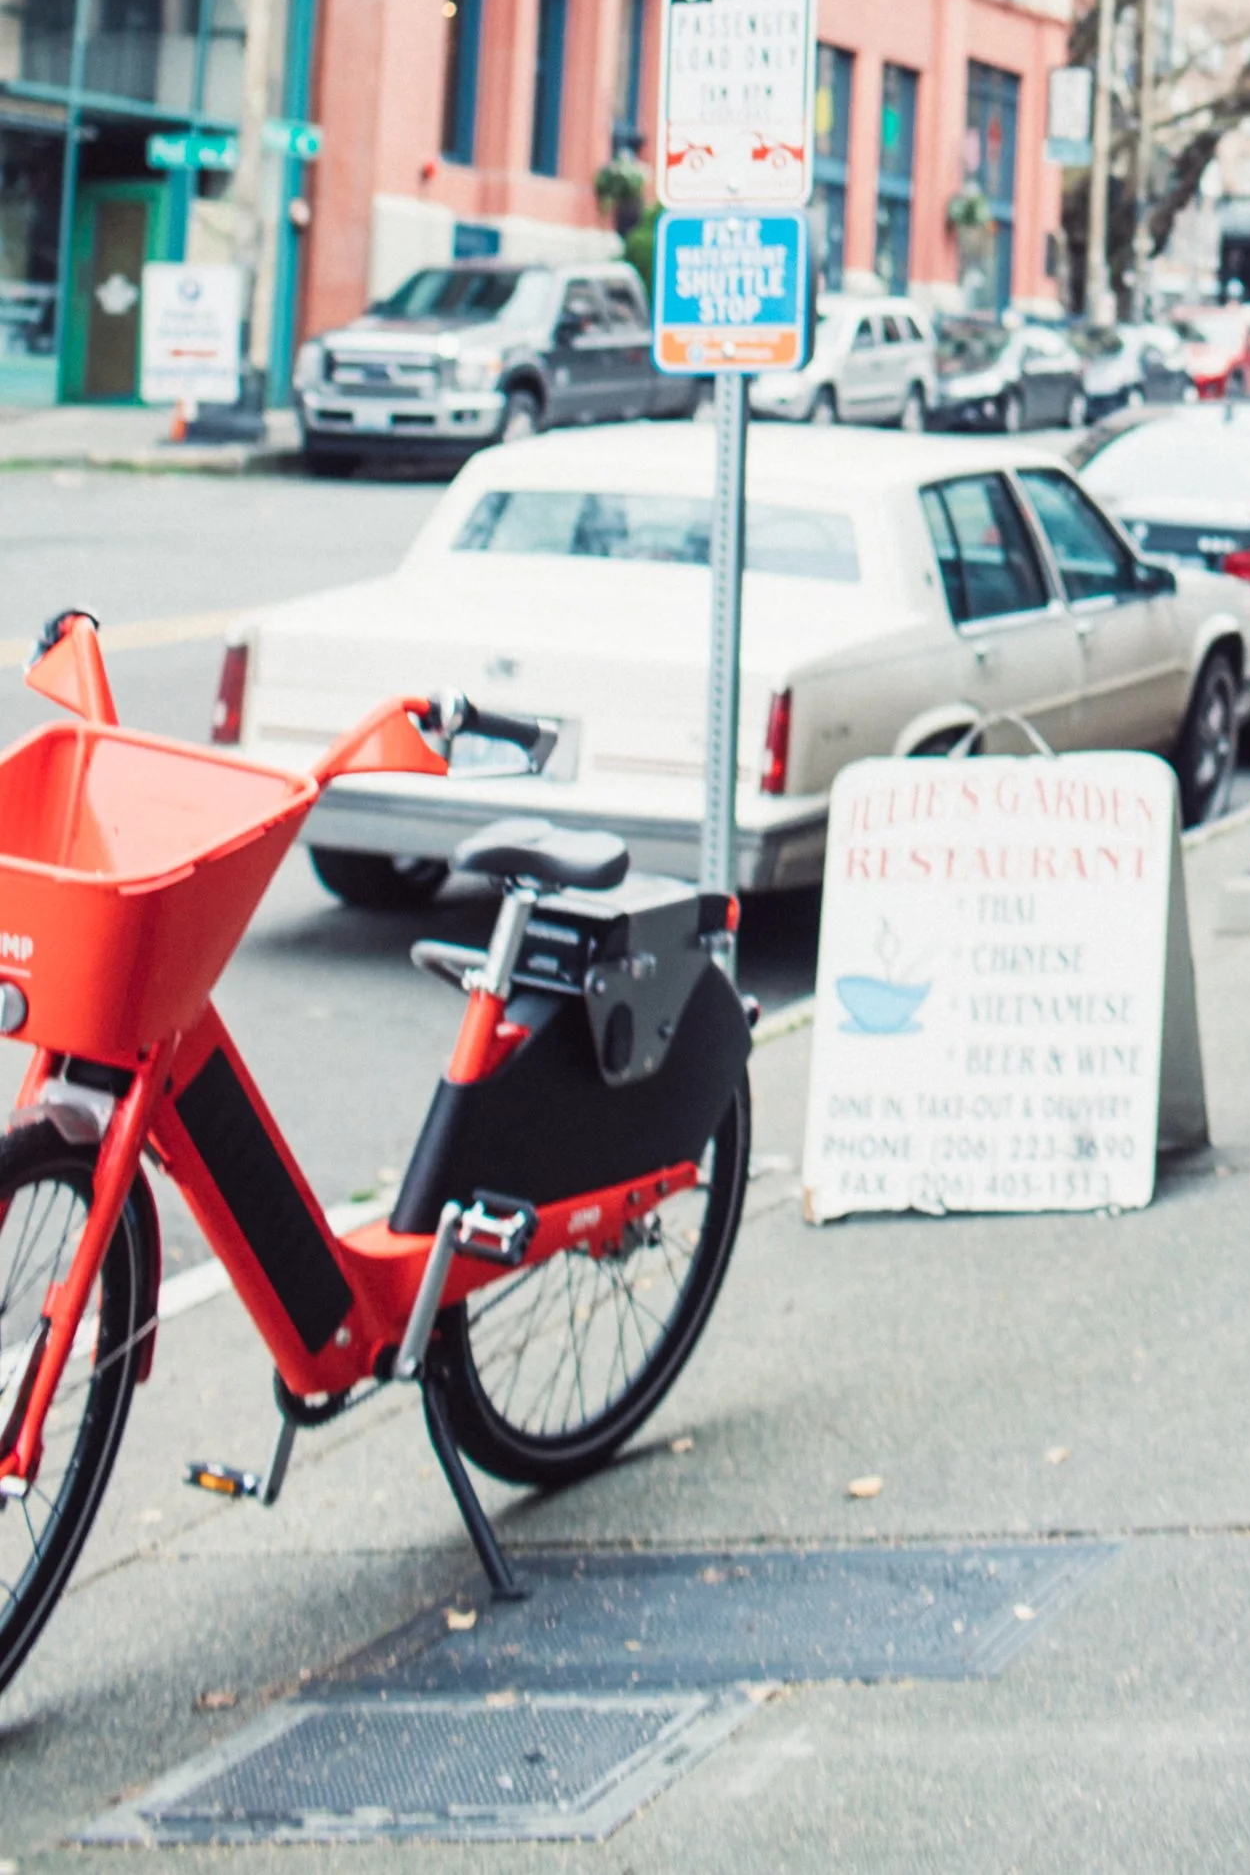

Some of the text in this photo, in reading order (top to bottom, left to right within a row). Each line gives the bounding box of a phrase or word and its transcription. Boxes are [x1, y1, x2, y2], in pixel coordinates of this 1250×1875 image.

[676, 9, 800, 39] PASSENGER
[674, 42, 798, 73] LOAD ONLY
[675, 267, 786, 299] SHUTTLE
[698, 295, 761, 323] STOP
[994, 775, 1157, 828] GARDEN
[845, 846, 1149, 880] RESTAURANT
[976, 894, 1036, 924] THAI
[971, 943, 1086, 974] CHINESE
[968, 994, 1133, 1024] VIETNAMESE
[965, 1043, 1035, 1075] BEER
[1076, 1043, 1142, 1075] WINE
